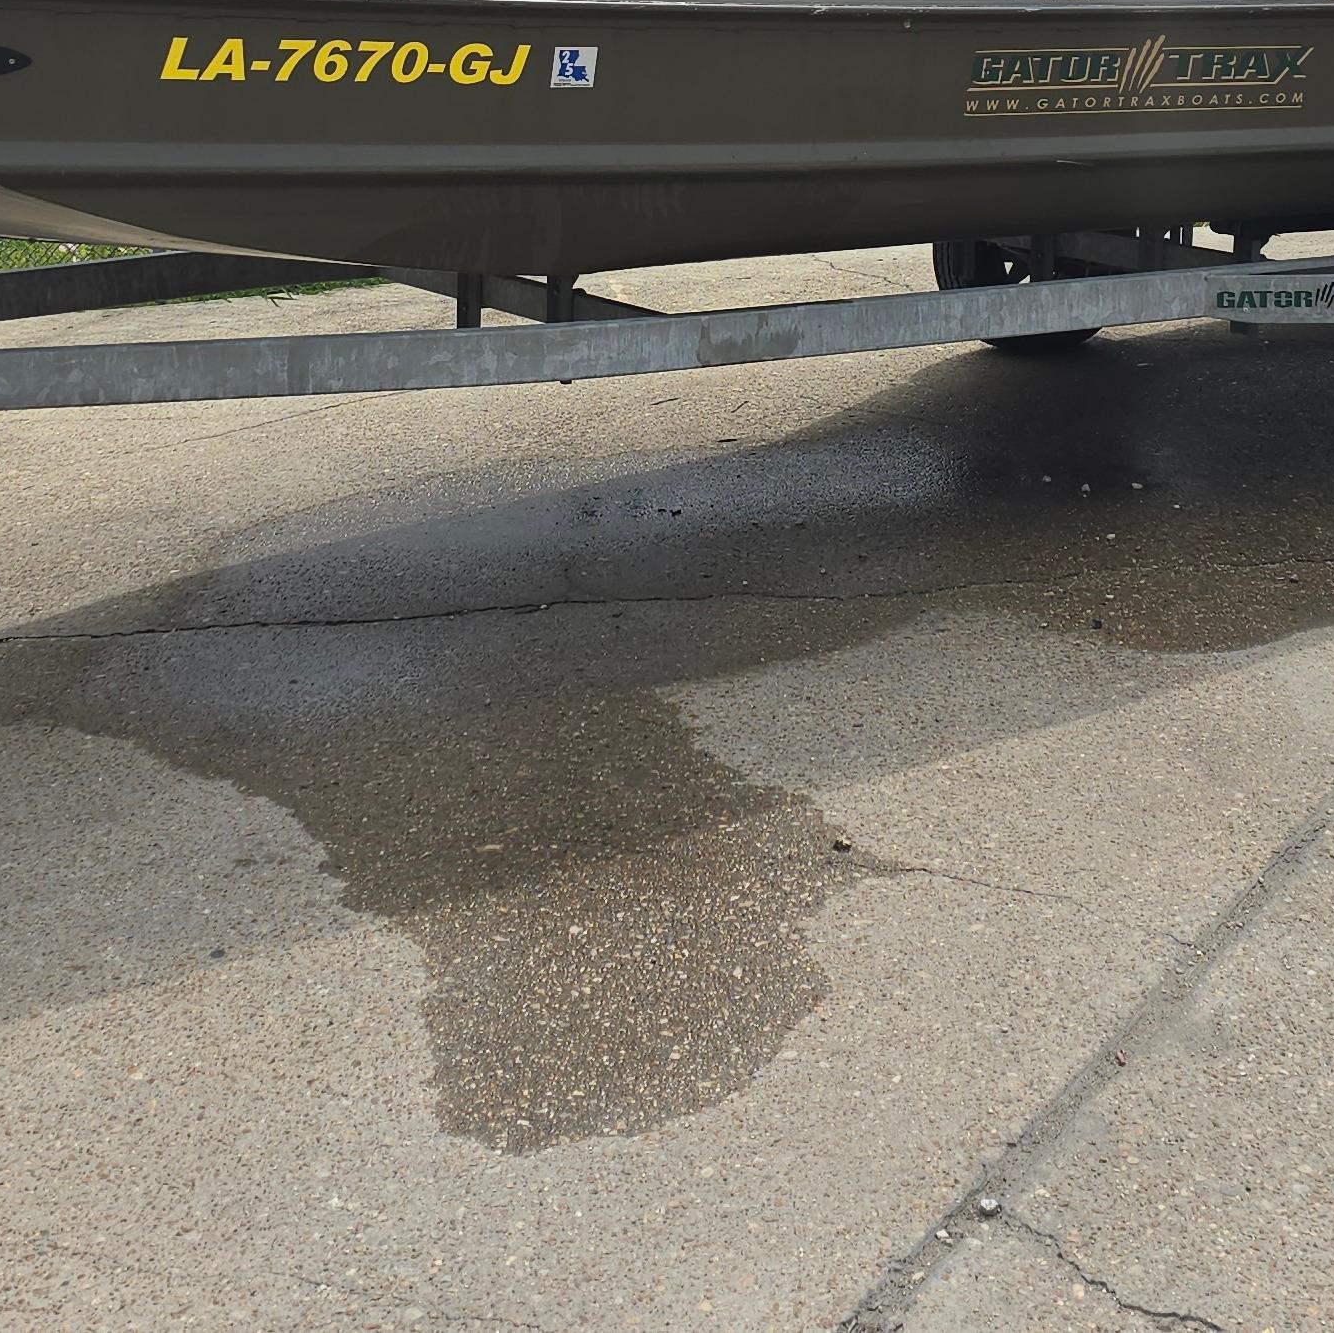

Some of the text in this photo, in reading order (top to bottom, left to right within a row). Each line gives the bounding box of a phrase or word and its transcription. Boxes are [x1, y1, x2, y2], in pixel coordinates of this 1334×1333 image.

[160, 37, 531, 85] LA-7670-GJ
[562, 50, 571, 64] 2
[971, 47, 1314, 85] GATOR TRAX
[565, 62, 574, 76] 5
[966, 92, 1304, 113] WWW.GATORTRAXBOATS.COM
[1217, 290, 1313, 309] GATOR
